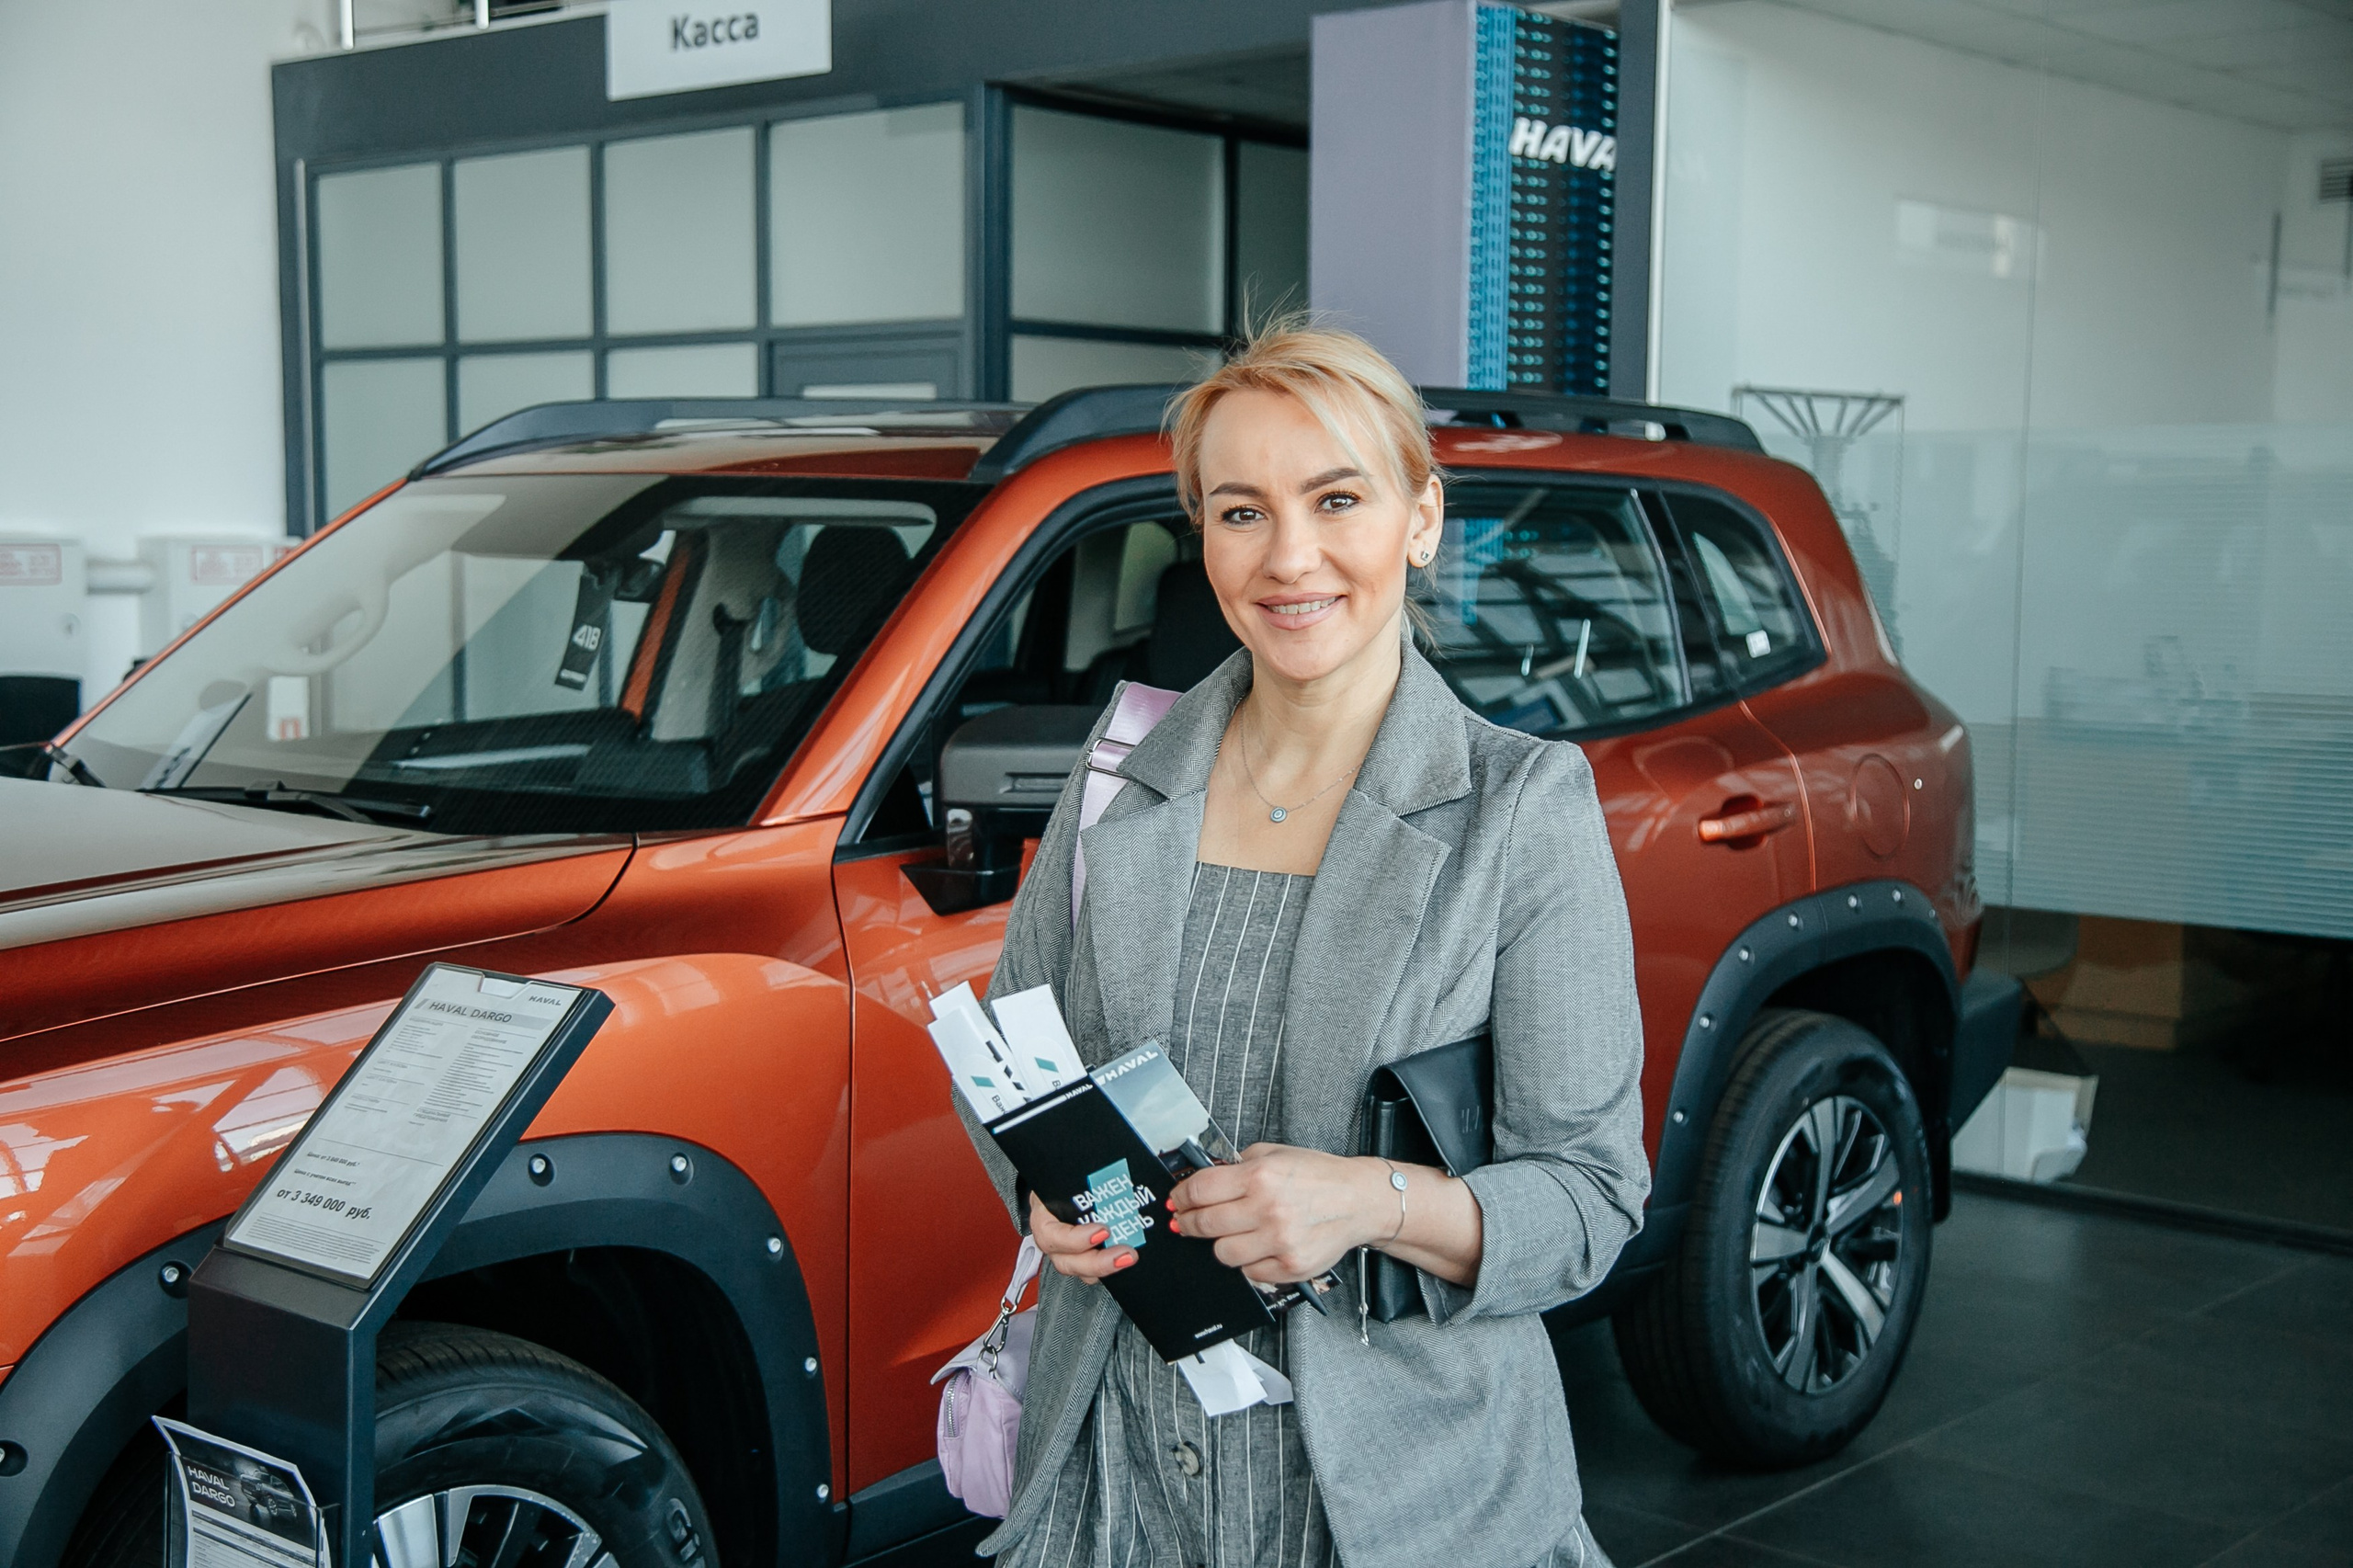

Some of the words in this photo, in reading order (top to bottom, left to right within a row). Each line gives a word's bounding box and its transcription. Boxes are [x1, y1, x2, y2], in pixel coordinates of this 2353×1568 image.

[671, 14, 759, 51] Касса
[1507, 117, 1617, 173] HAVA
[429, 1001, 468, 1017] HAVAL
[470, 1008, 512, 1023] DARGO
[529, 994, 563, 1006] HAVAL
[1106, 1050, 1159, 1083] HAVAL
[1064, 1083, 1094, 1100] HAVAL
[277, 1189, 291, 1199] от
[291, 1190, 301, 1201] 3
[301, 1193, 324, 1207] 349
[322, 1198, 346, 1212] 000
[345, 1206, 372, 1220] руб.
[1072, 1174, 1134, 1211] ВАЖЕН
[1109, 1213, 1154, 1244] ДЕНЬ
[188, 1465, 230, 1491] HAVAL
[191, 1481, 236, 1507] DARGO
